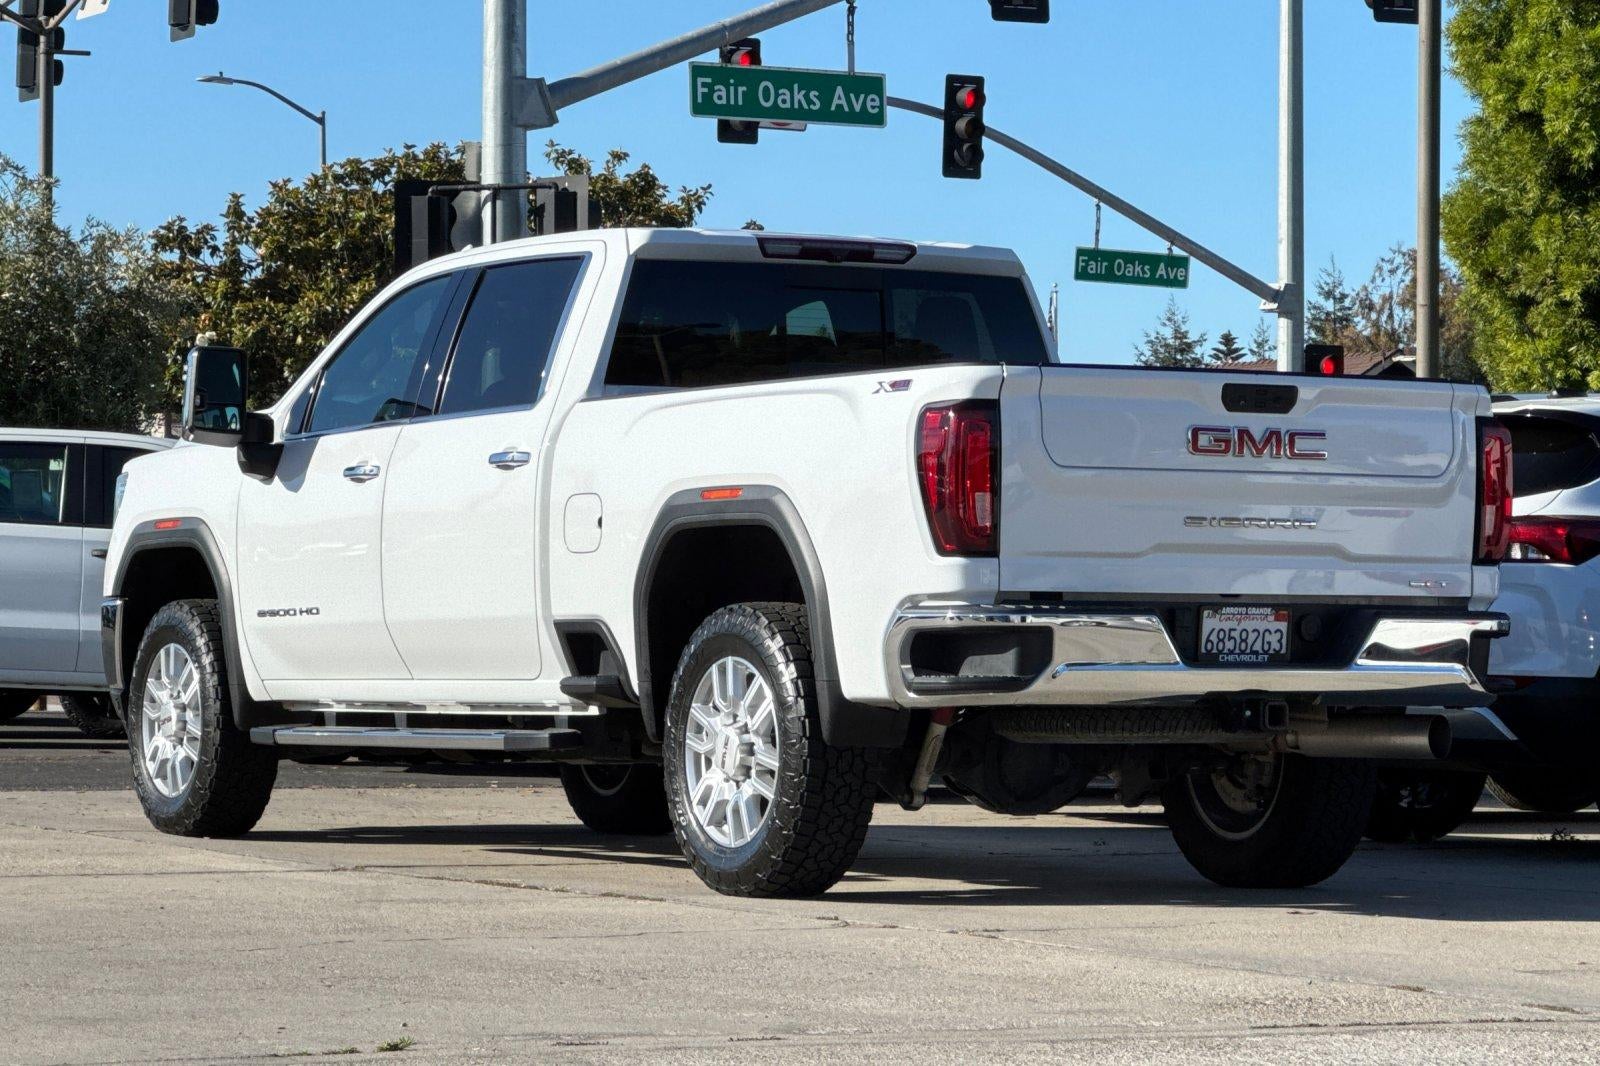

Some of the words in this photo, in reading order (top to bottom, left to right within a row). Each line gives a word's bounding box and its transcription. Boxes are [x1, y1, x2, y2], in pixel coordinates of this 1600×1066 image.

[696, 77, 747, 105] Fair
[758, 80, 821, 110] Oaks
[830, 85, 880, 114] Ave
[1078, 256, 1108, 274] Fair
[1114, 259, 1151, 278] Oaks
[1156, 262, 1186, 280] Ave
[1187, 424, 1328, 460] GMC
[1184, 516, 1317, 529] SIERRA
[299, 607, 320, 616] HD
[1221, 606, 1246, 614] ARROYO
[1247, 607, 1273, 615] GRANDE
[1219, 614, 1269, 626] California
[1204, 627, 1284, 653] 68582G3
[1218, 654, 1270, 662] CHEVROLET
